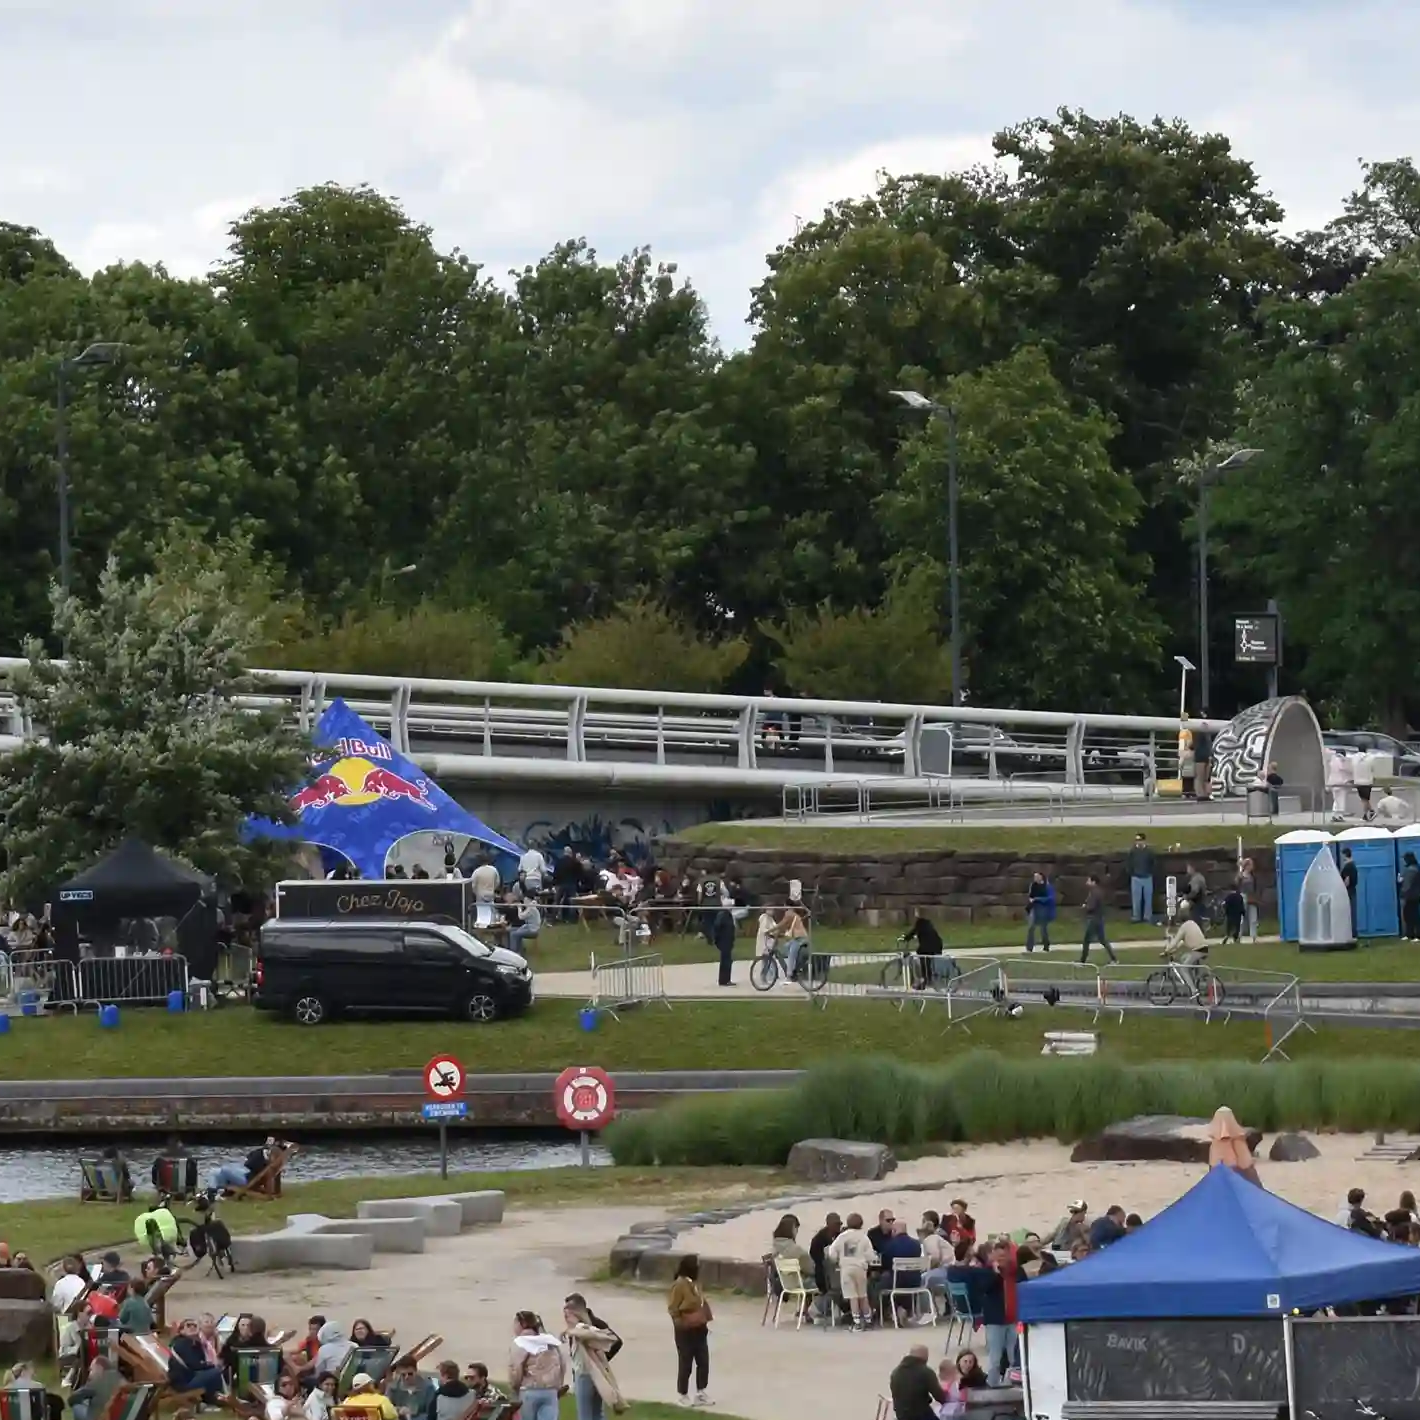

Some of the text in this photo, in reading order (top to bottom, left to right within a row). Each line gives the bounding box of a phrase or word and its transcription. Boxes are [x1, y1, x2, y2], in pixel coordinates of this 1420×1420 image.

[304, 737, 393, 767] ed Bull
[336, 889, 424, 913] Chez Jojo
[1106, 1333, 1148, 1351] BAVIK
